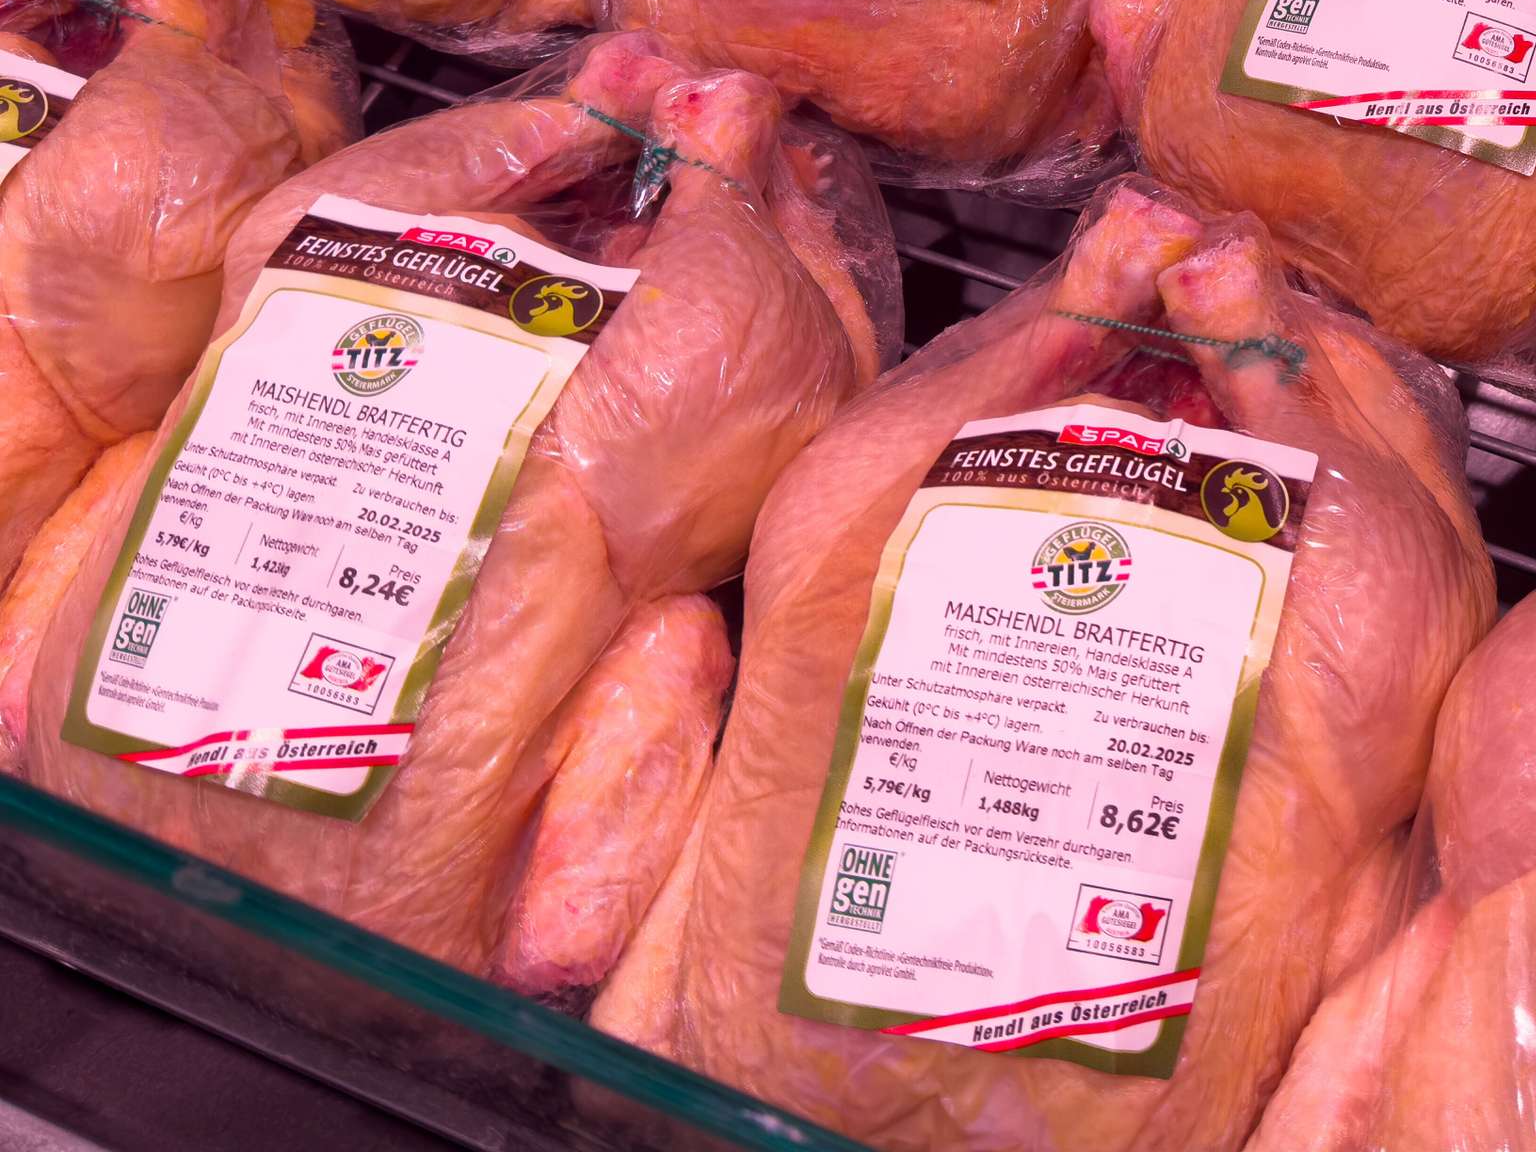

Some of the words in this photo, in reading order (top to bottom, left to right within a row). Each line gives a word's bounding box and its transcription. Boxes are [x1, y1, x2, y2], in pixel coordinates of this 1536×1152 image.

[417, 229, 491, 254] SPAR
[296, 235, 387, 264] FEINSTES
[392, 248, 503, 294] GEFLÜGEL
[346, 346, 403, 370] TITZ
[251, 379, 352, 419] MAISHENDL
[357, 405, 467, 447] BRATFERTIG
[1081, 427, 1164, 453] SPAR
[941, 470, 987, 485] 100%
[996, 472, 1028, 483] aus
[1036, 470, 1144, 498] Österreich
[951, 448, 1060, 470] FEINSTES
[1066, 450, 1188, 493] GEFLÜGEL
[357, 507, 442, 543] 20.02.2025
[1040, 524, 1119, 564] GEFLÜGEL
[338, 566, 416, 608] 8,24€
[1046, 560, 1115, 589] TITZ
[1050, 589, 1113, 610] STEIERMARK
[944, 601, 1066, 639] MAISHENDL
[1074, 621, 1205, 664] BRATFERTIG
[944, 625, 984, 646] frisch,
[1016, 635, 1081, 660] Innereien,
[1084, 646, 1179, 676] Handelsklasse
[973, 648, 1048, 671] mindestens
[1052, 658, 1083, 675] 50%
[1086, 664, 1119, 681] Mais
[1124, 669, 1180, 696] gefüttert
[277, 738, 378, 759] Österreich
[1107, 737, 1195, 767] 20.02.2025
[863, 775, 931, 803] 5,79€/kg
[983, 770, 1072, 800] Nettogewicht
[977, 796, 1040, 822] 1,488kg
[1150, 795, 1185, 815] Preis
[1099, 804, 1179, 841] 8,62€
[842, 847, 894, 878] OHNE
[834, 877, 888, 910] gen
[1085, 937, 1146, 958] 10056583
[973, 1019, 1024, 1044] Hendl
[1031, 1013, 1064, 1031] aus
[1069, 990, 1168, 1024] Österreich
